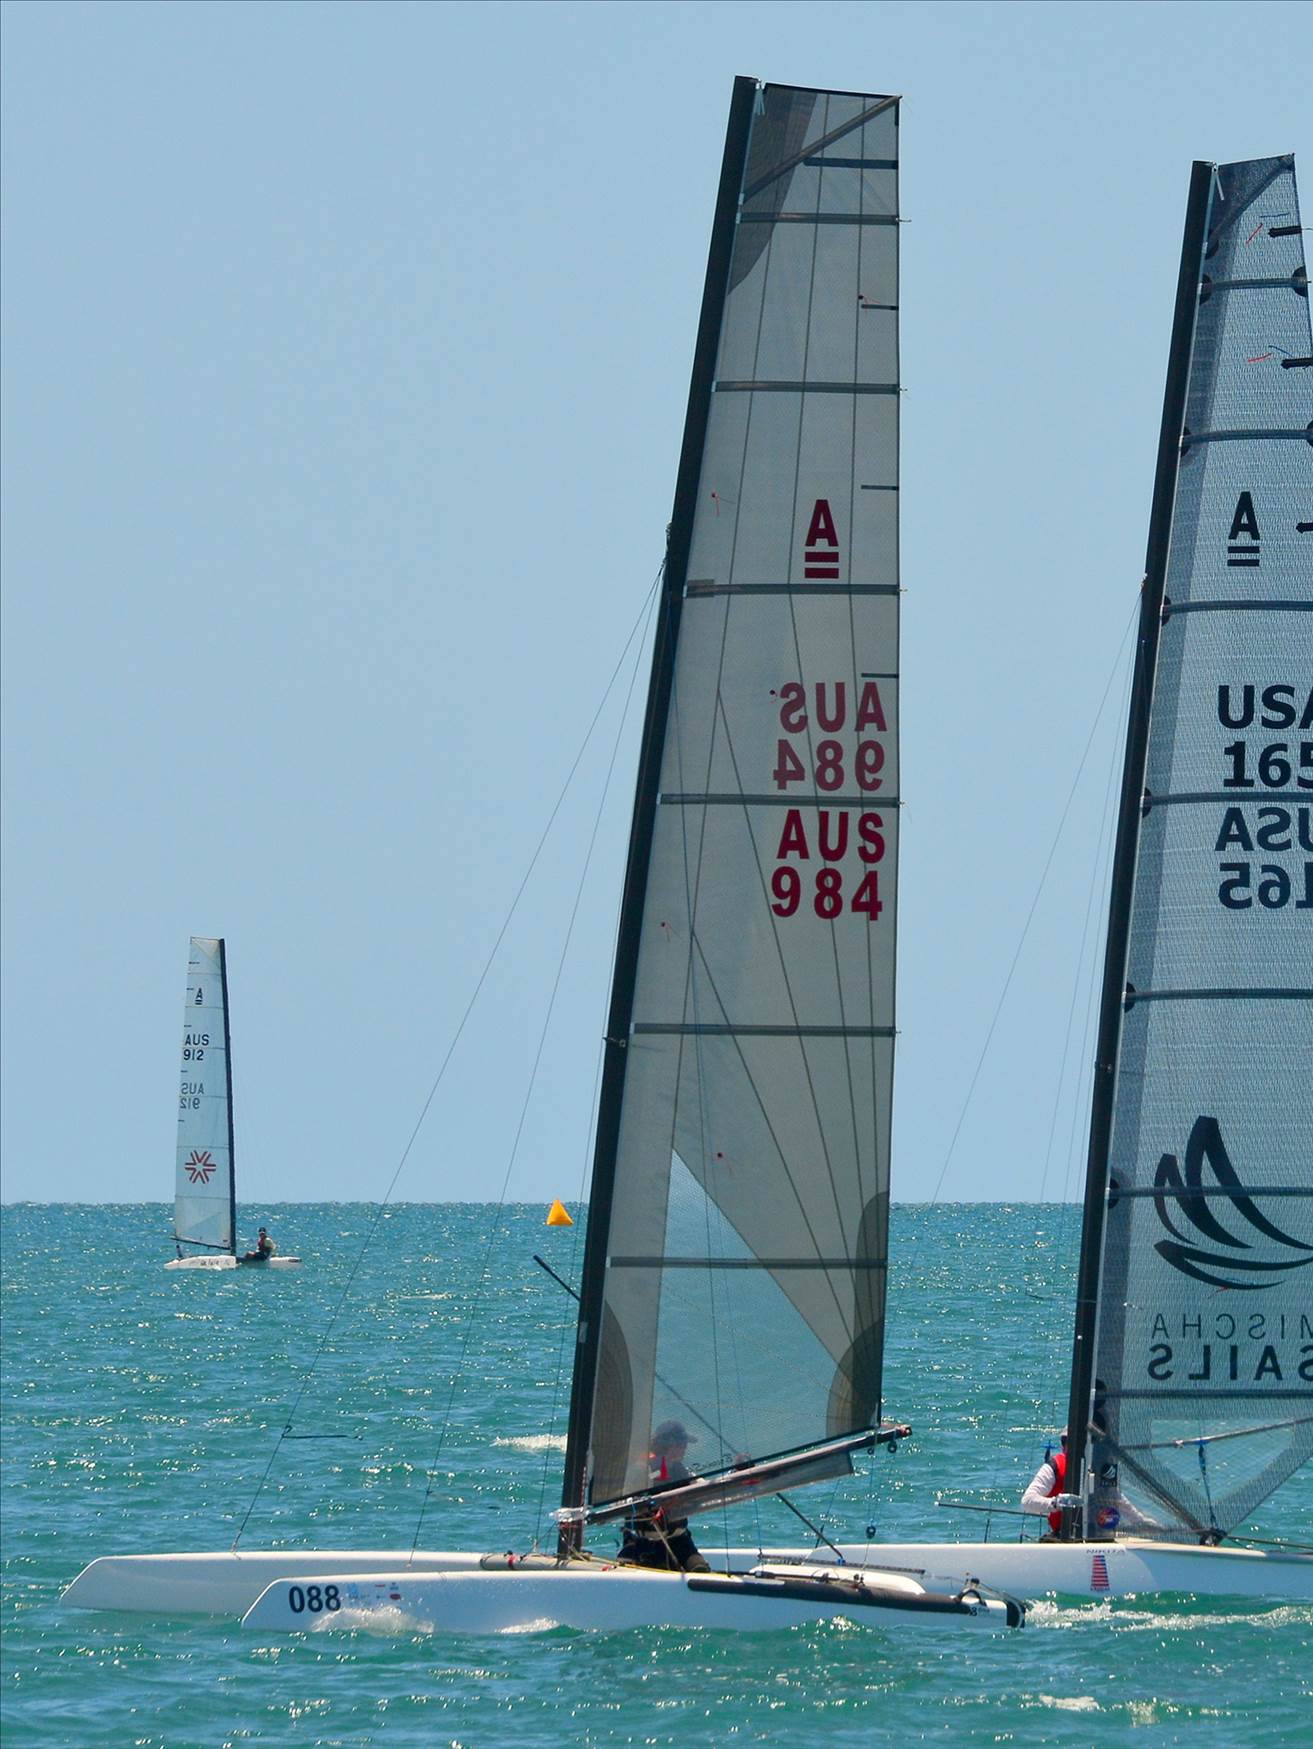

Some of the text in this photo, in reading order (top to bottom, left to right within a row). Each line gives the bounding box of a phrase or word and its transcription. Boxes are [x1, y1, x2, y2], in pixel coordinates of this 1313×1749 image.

[805, 499, 839, 547] A
[1229, 491, 1260, 541] A
[776, 809, 885, 863] AUS
[771, 866, 883, 921] 984
[183, 1049, 204, 1061] 912
[184, 1033, 210, 1046] AUS
[289, 1585, 341, 1614] 088
